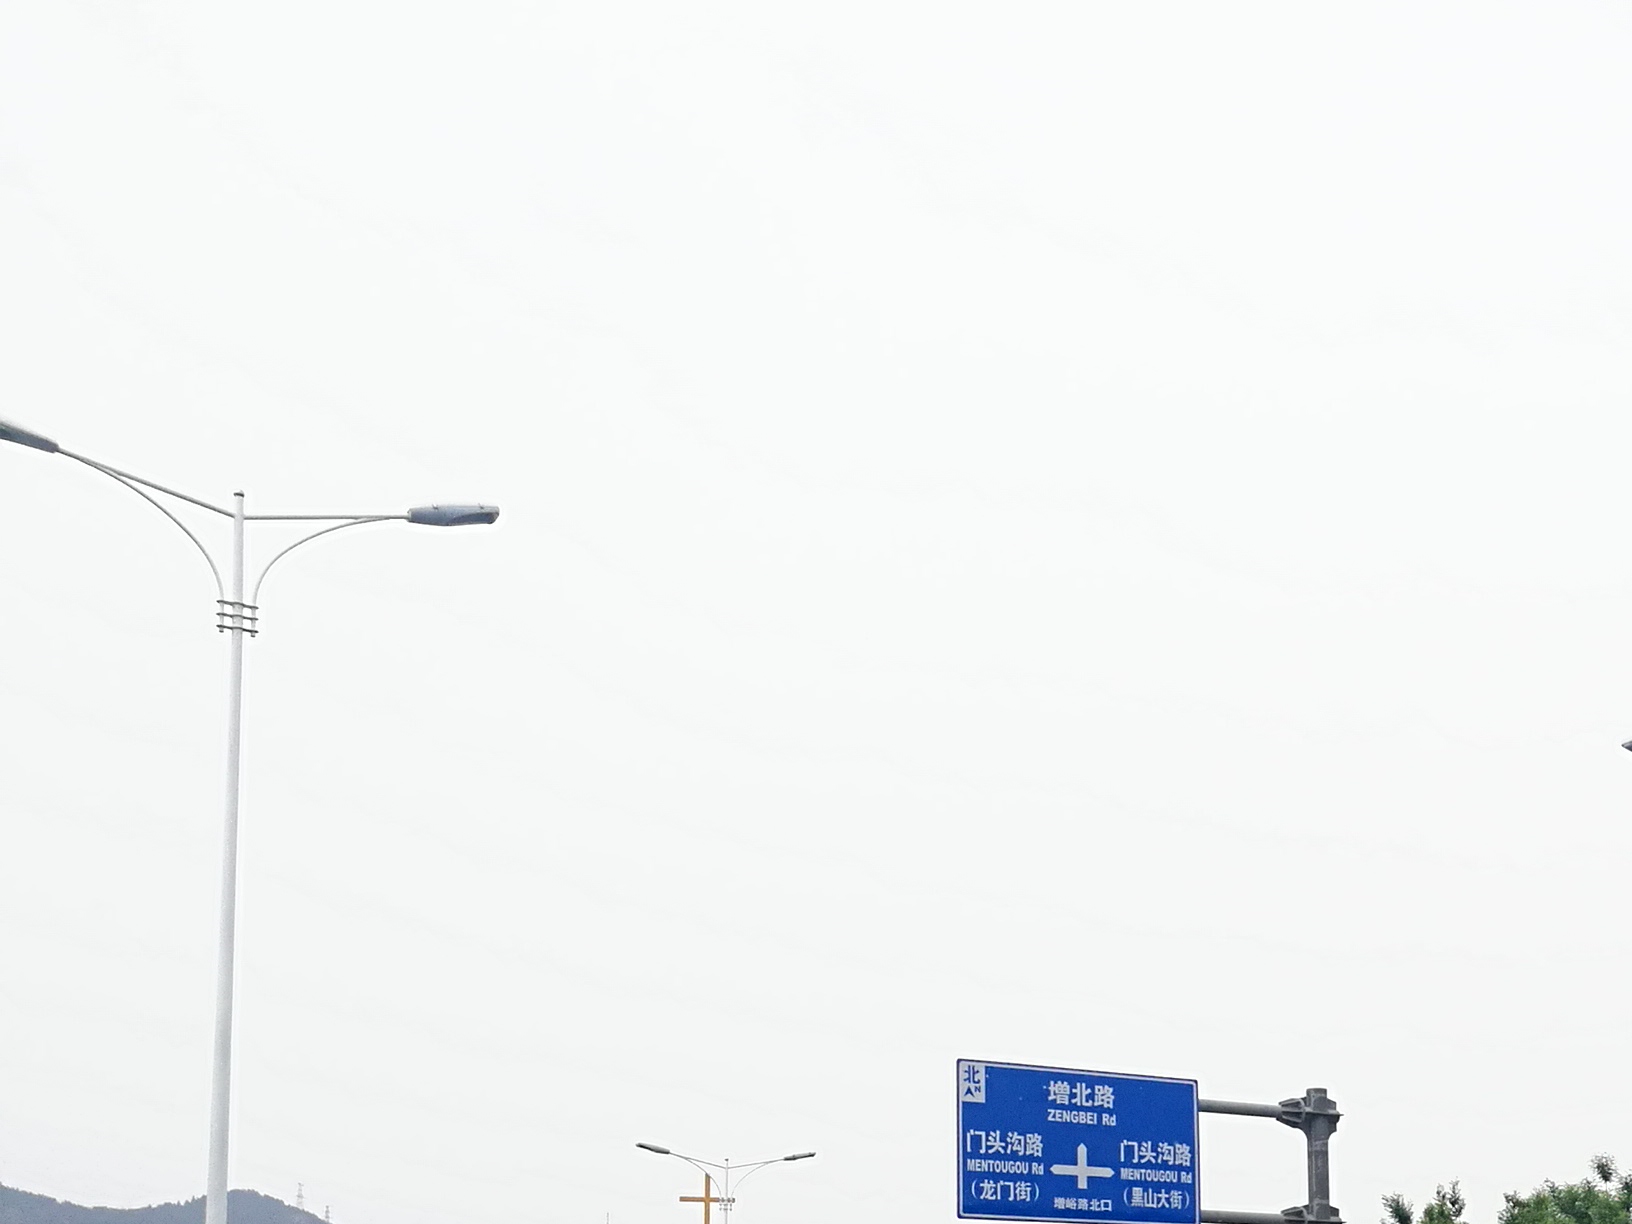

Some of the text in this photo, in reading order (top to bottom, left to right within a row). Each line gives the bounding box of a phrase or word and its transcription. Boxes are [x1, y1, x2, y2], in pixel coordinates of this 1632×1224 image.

[963, 1065, 980, 1084] 北
[974, 1086, 981, 1094] N
[1047, 1080, 1115, 1109] 增北路
[1047, 1108, 1116, 1126] ZENGBEI Rd
[966, 1129, 1043, 1157] 门头沟路
[1120, 1140, 1192, 1167] 门头沟路
[966, 1158, 1044, 1175] MENTOUGOU Rd
[1120, 1167, 1193, 1184] MENTOUGOU Rd
